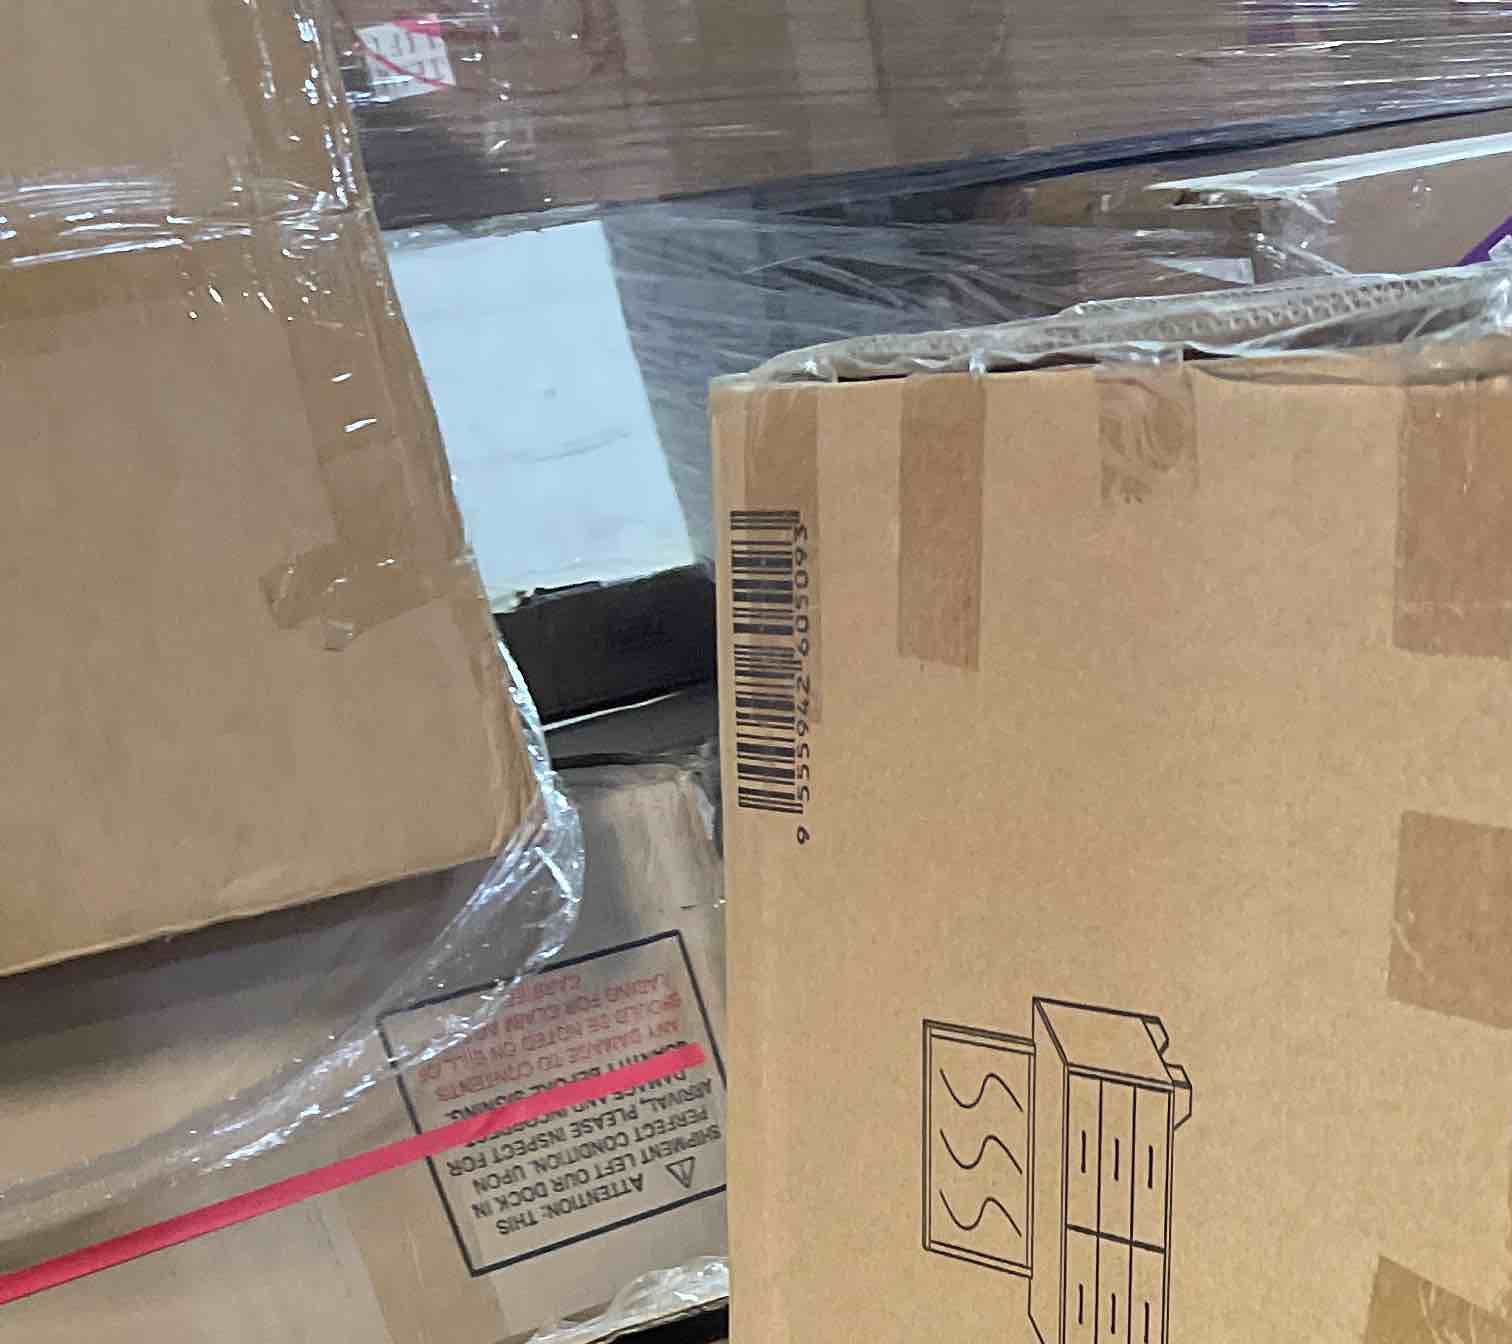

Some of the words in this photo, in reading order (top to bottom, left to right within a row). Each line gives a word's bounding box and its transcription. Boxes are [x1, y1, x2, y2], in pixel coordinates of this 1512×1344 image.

[794, 524, 809, 656] 605093
[795, 676, 809, 802] 555942
[568, 1102, 639, 1138] PLEASE
[631, 1103, 709, 1142] PERFECT
[489, 1125, 567, 1164] INSPECT
[636, 1122, 723, 1165] SHIPMENT
[445, 1150, 487, 1178] FOR
[470, 1162, 526, 1194] UPON
[549, 1167, 590, 1193] OUR
[591, 1151, 636, 1179] LEFT
[470, 1197, 494, 1219] IN
[497, 1179, 548, 1210] DOCK
[538, 1171, 647, 1222] ATTENTION:
[494, 1208, 538, 1237] THIS
